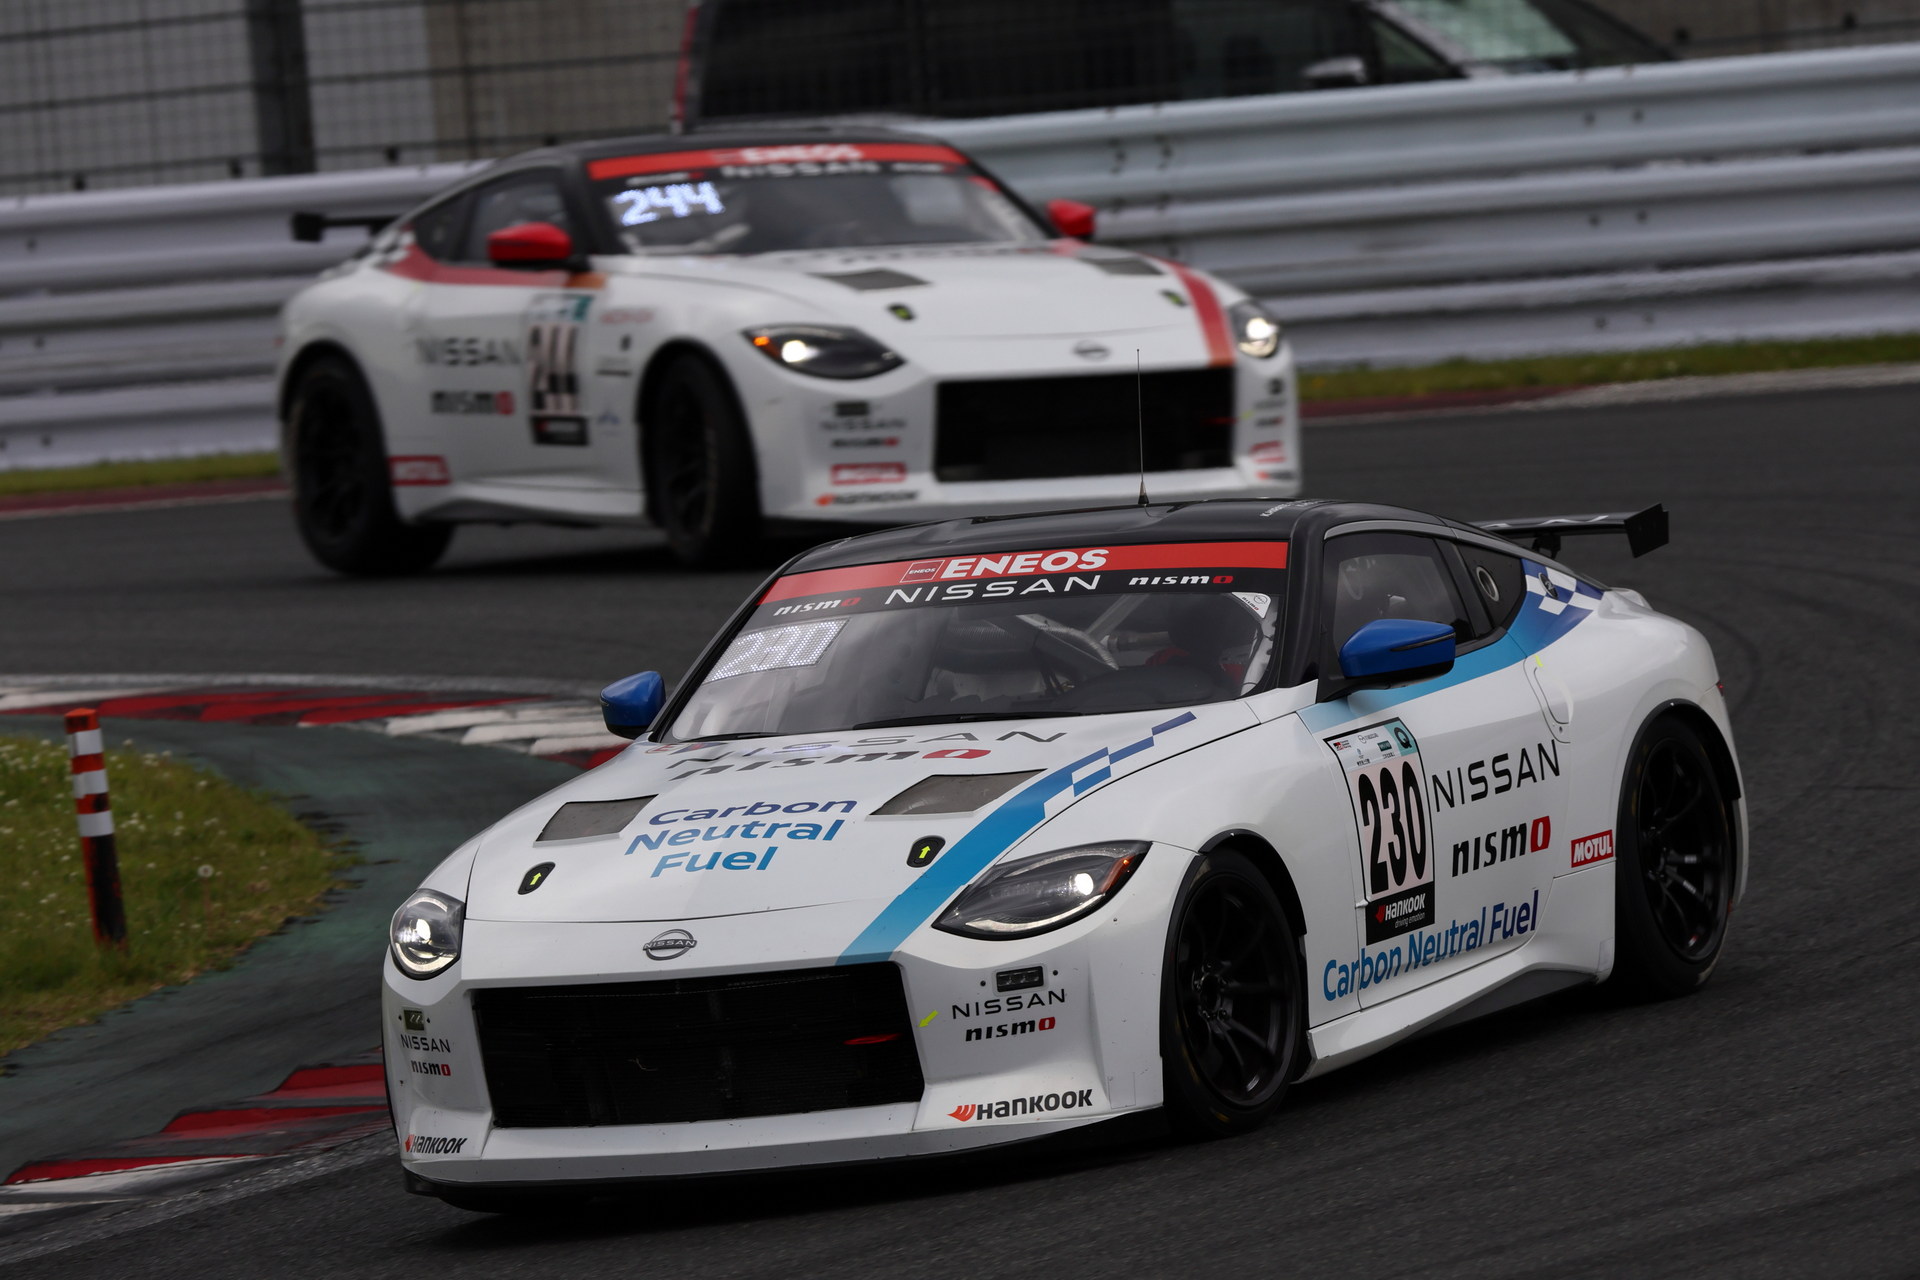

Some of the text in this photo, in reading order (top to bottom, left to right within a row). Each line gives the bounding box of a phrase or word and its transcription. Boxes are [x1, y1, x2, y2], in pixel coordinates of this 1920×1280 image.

[613, 181, 725, 227] 244
[908, 567, 936, 575] ENEOS
[940, 549, 1109, 579] ENEOS
[884, 574, 1101, 604] NISSAN
[1128, 575, 1234, 586] nismo
[773, 596, 861, 616] nismo
[666, 731, 1068, 769] NISSAN
[1394, 727, 1412, 749] Q
[668, 749, 991, 782] nismo
[1432, 739, 1560, 812] NISSAN
[648, 800, 857, 826] Carbon
[1358, 761, 1426, 895] 230
[624, 819, 847, 856] Neutral
[1452, 816, 1551, 877] nismo
[1573, 833, 1613, 864] MOTUL
[650, 846, 779, 878] Fuel
[643, 939, 696, 949] NISSAN
[1323, 889, 1539, 1001] Carbon Neutral Fuel
[952, 988, 1066, 1020] NISSAN
[400, 1034, 451, 1053] NISSAN
[965, 1016, 1056, 1042] nismo
[411, 1060, 451, 1076] nismo
